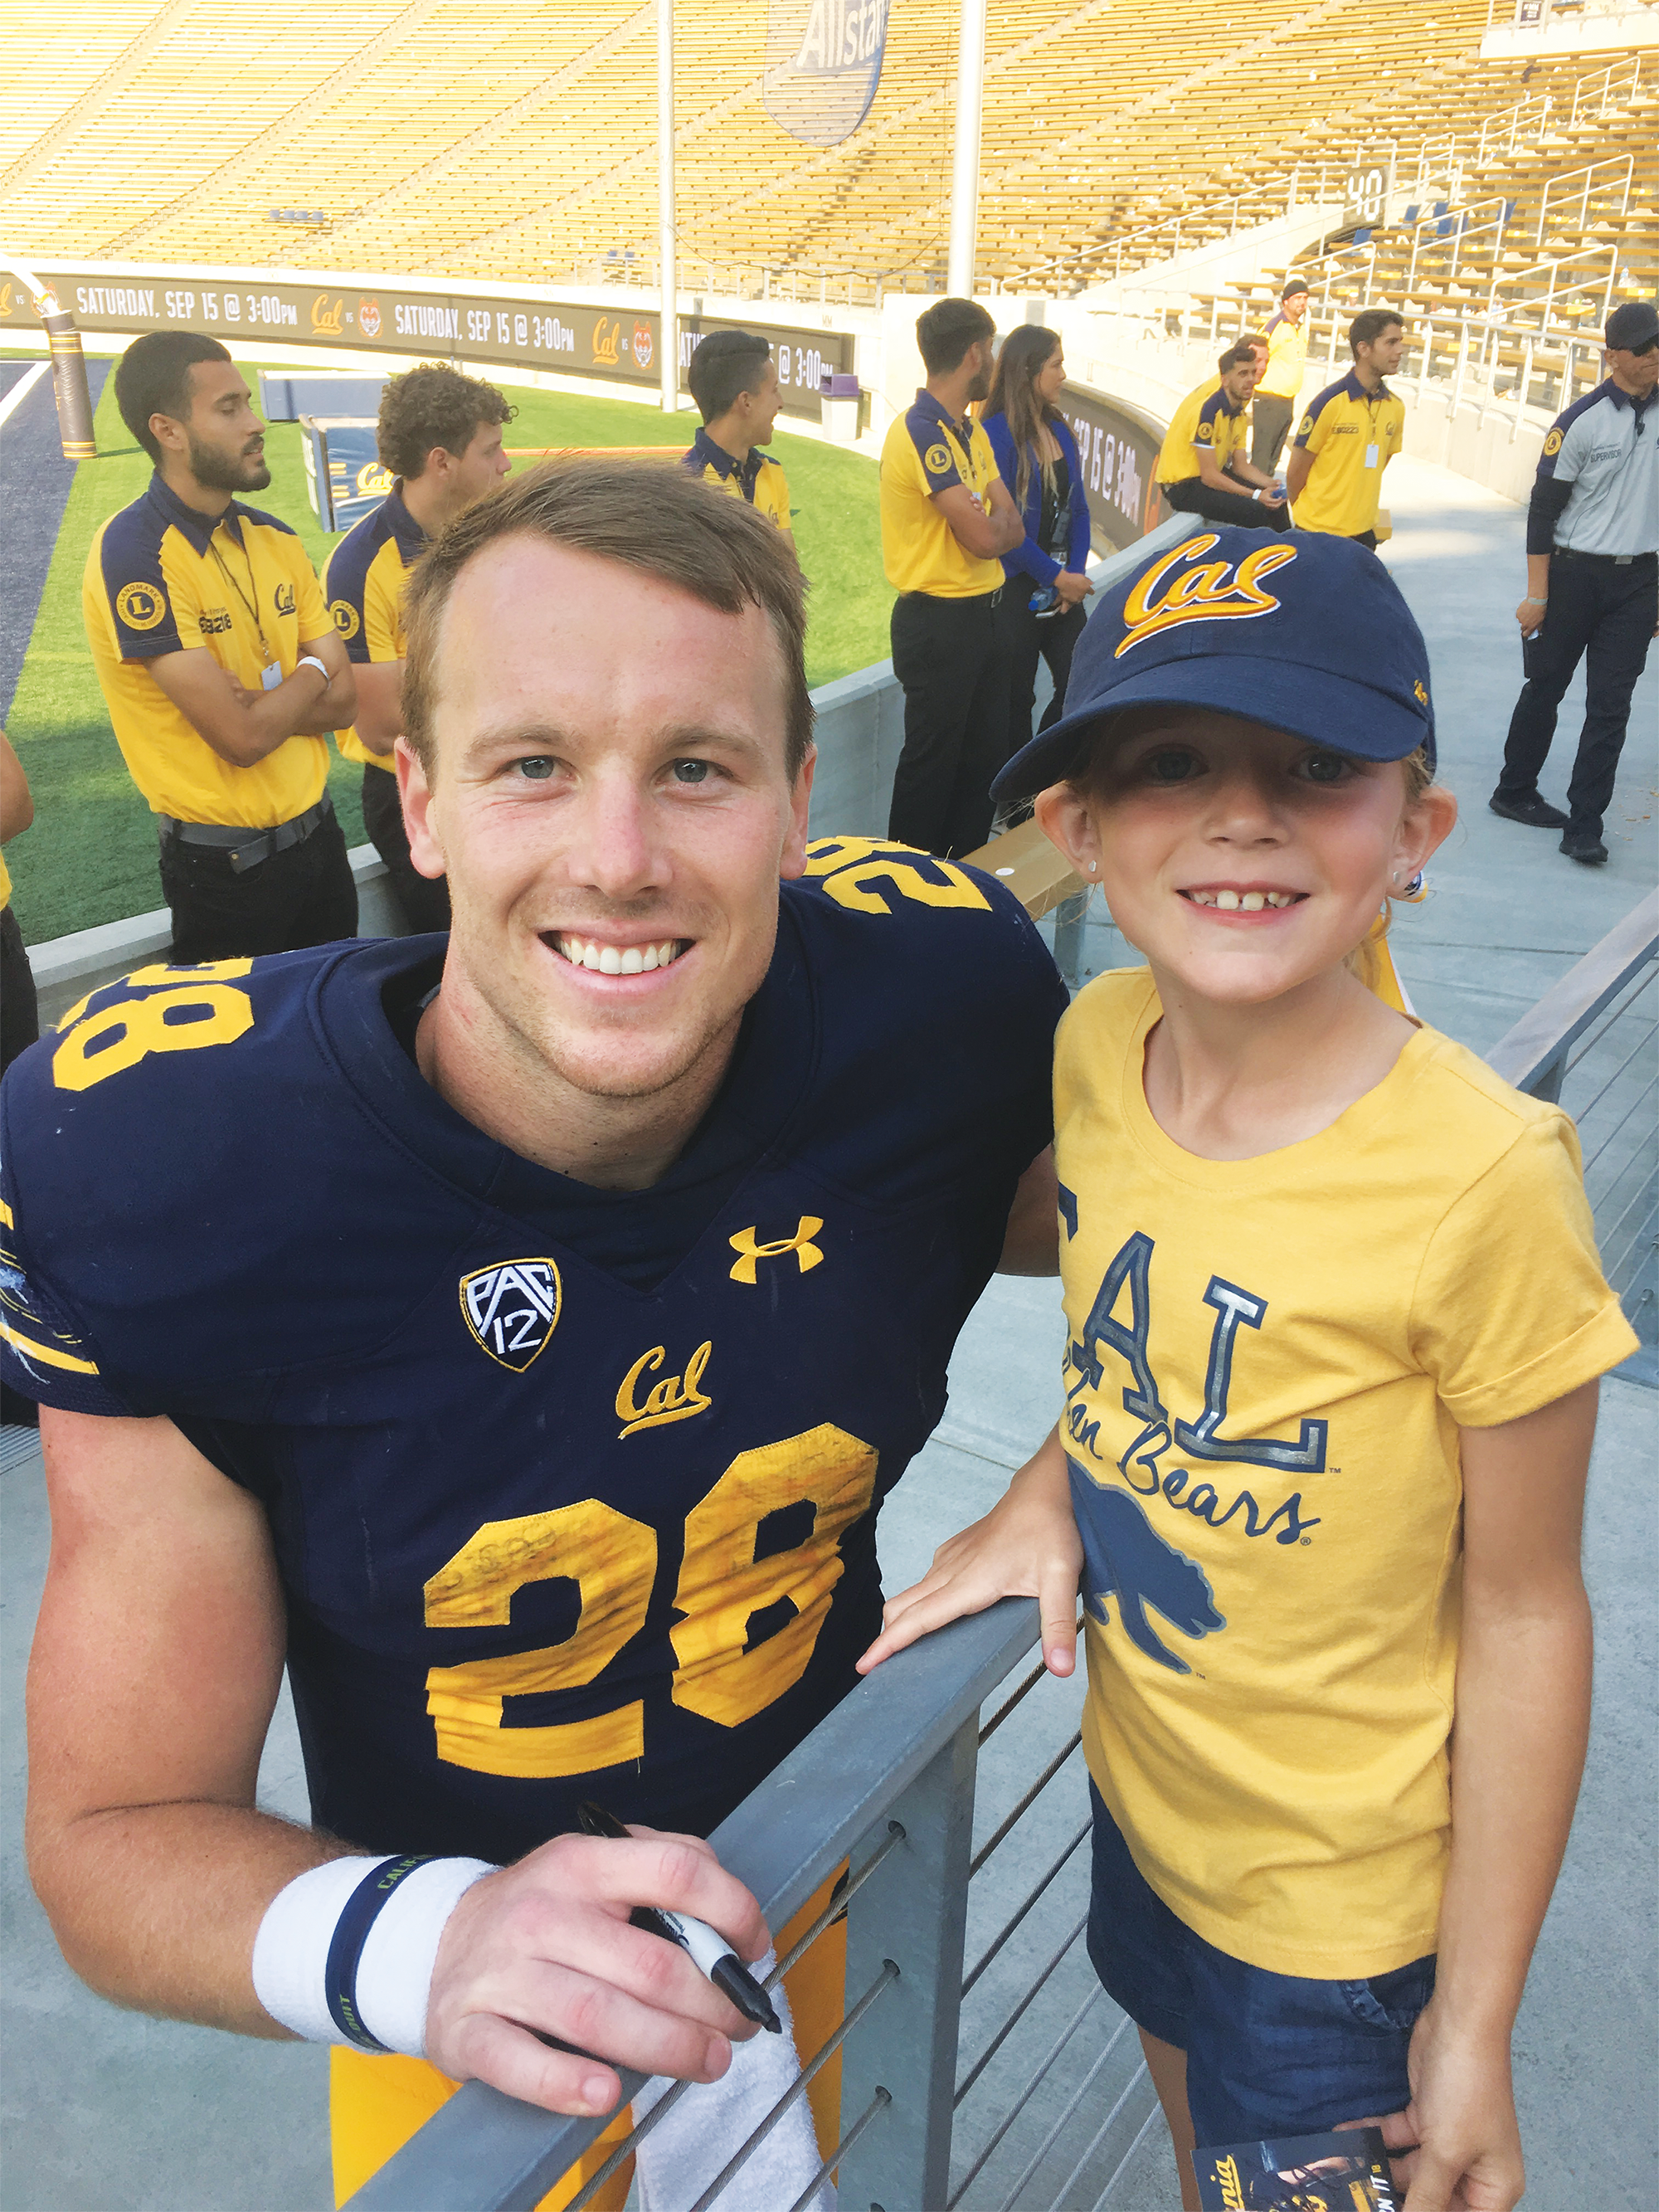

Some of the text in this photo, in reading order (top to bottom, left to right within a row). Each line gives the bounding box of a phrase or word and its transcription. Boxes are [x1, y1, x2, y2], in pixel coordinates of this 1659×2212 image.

[1347, 169, 1383, 222] 40
[76, 287, 298, 325] SATURDAY, SEP 15 @ 3:00PM
[310, 293, 344, 336] Cal
[394, 304, 575, 353] SATURDAY, SEP 15 @ 3:00PM
[592, 315, 620, 365] Cal
[778, 344, 791, 385] @
[932, 452, 946, 465] L
[1590, 448, 1623, 463] SUPERVISOR
[356, 461, 395, 496] Cal
[118, 583, 159, 603] LANDMARK
[129, 596, 151, 615] L
[1114, 533, 1297, 659] Cal
[335, 611, 348, 627] L
[466, 1264, 555, 1337] PAC
[492, 1309, 542, 1354] 12
[1059, 1182, 1328, 1474] AL
[615, 1340, 713, 1440] Cal
[1115, 1420, 1321, 1546] Bears
[423, 1421, 880, 1780] 28
[1370, 2175, 1390, 2191] IT
